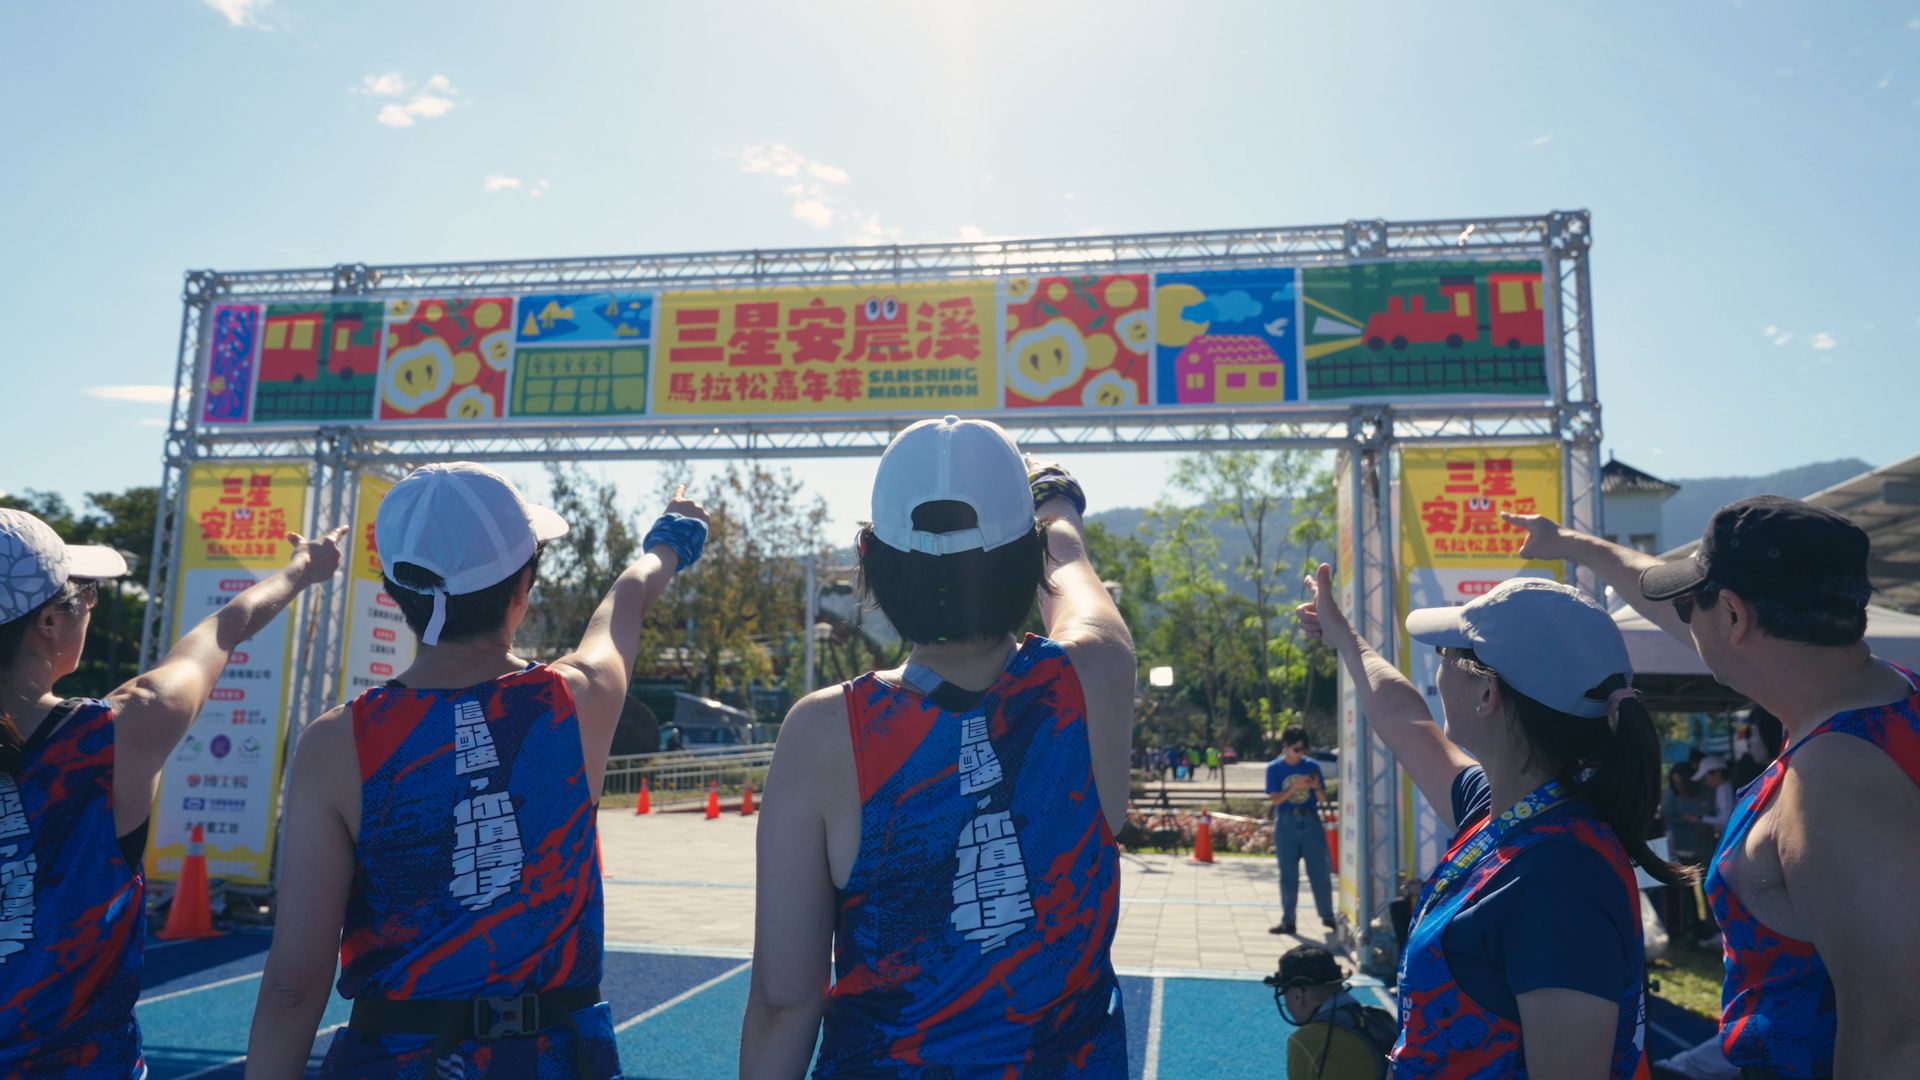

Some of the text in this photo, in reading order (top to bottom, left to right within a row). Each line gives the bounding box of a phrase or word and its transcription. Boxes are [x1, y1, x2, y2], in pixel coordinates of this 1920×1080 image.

[669, 296, 982, 367] 三星安農溪
[667, 368, 864, 403] 馬拉松嘉年華
[868, 367, 979, 384] SANSHING
[868, 384, 979, 399] MARATHON
[219, 474, 272, 507] 三星
[1444, 459, 1517, 496] 三星
[200, 507, 287, 540] 安農溪
[156, 857, 256, 878] SAHING
